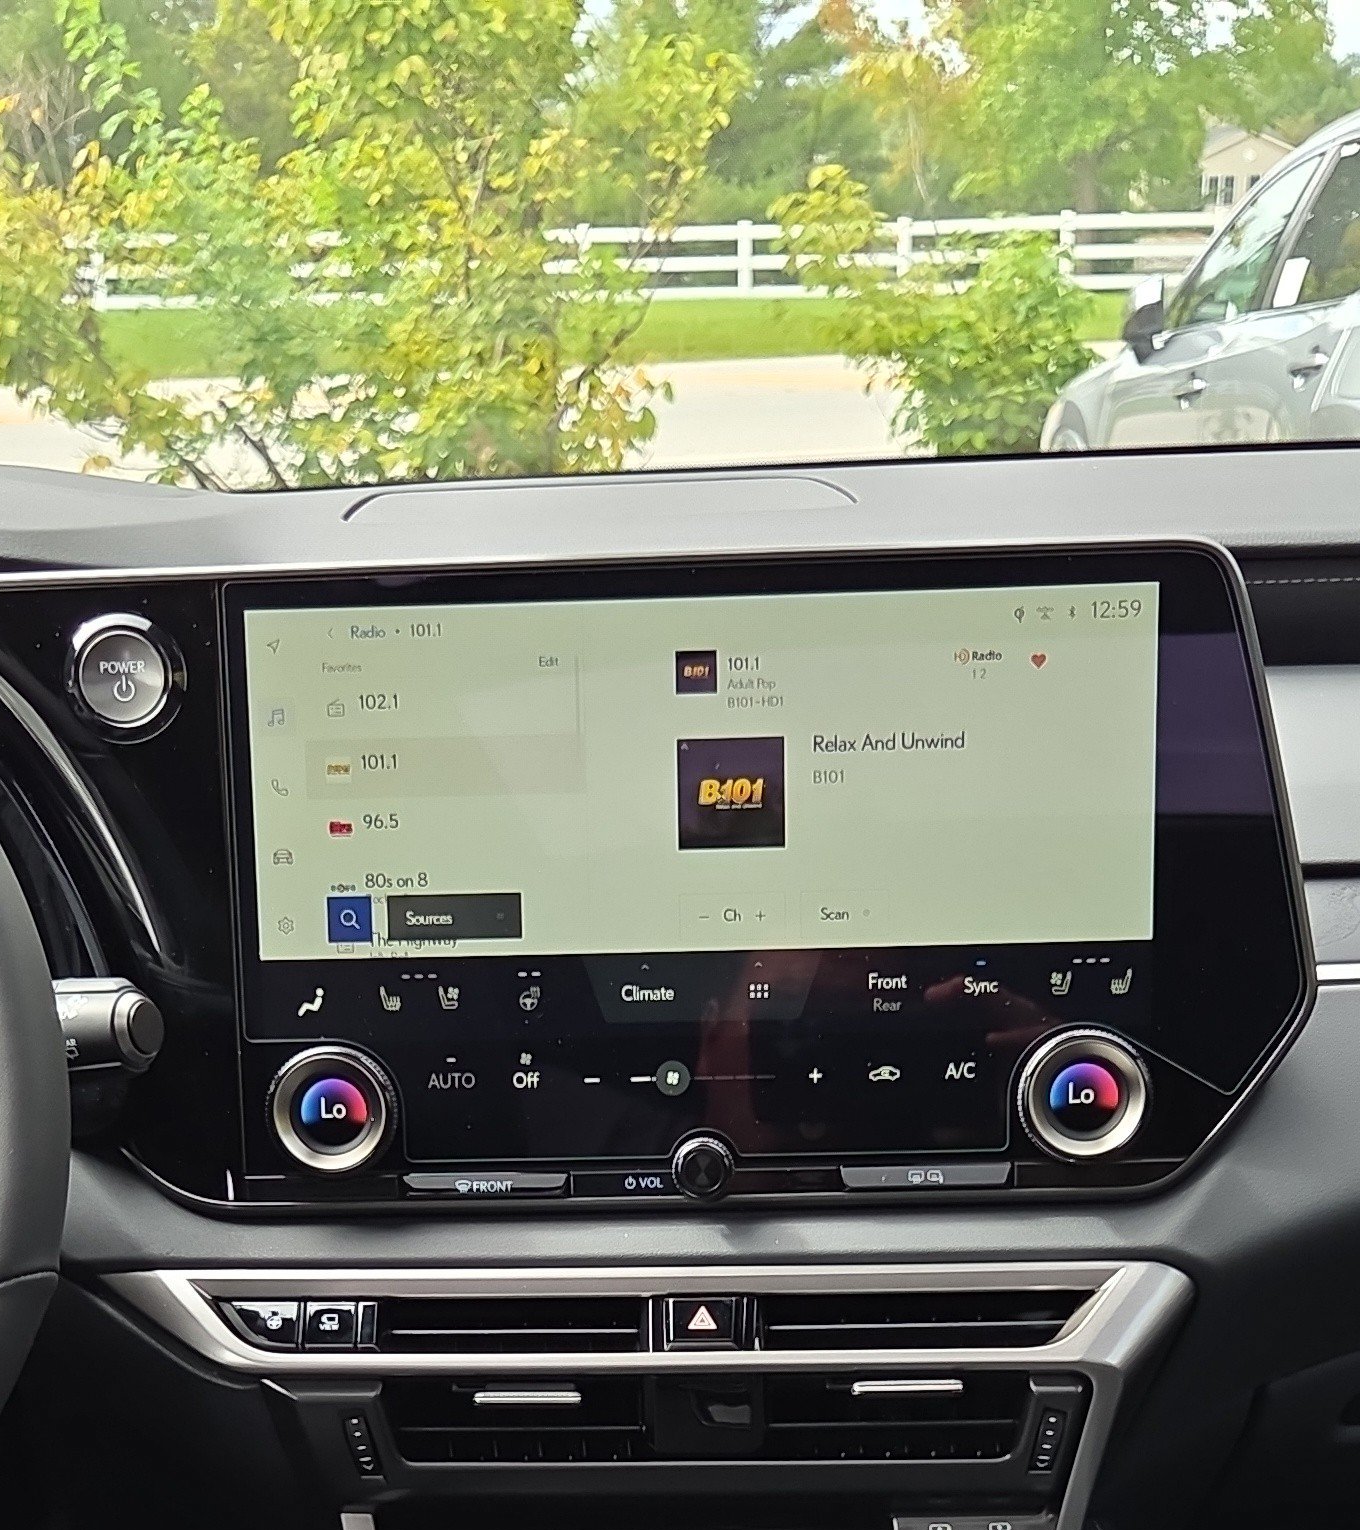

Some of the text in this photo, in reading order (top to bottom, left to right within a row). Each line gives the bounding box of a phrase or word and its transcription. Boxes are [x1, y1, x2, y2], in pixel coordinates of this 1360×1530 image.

[1091, 600, 1142, 619] 12:59
[350, 622, 443, 640] Radio 101.1
[728, 657, 760, 671] 101.1
[972, 651, 1002, 661] Radio
[99, 661, 145, 674] POWER
[321, 656, 559, 674] Favorites Edit
[727, 678, 777, 691] Adult Pop
[358, 693, 399, 711] 102.1
[727, 696, 784, 708] B101-HD1
[813, 731, 966, 753] Relax And Unwind
[361, 753, 398, 770] 101.1
[813, 770, 845, 784] B101
[698, 778, 764, 806] B101
[363, 813, 399, 829] 96.5
[365, 873, 393, 888] 80s
[397, 876, 414, 888] on
[417, 871, 429, 888] 8
[405, 910, 453, 926] Sources
[723, 907, 742, 923] Ch
[820, 907, 849, 922] Scan
[621, 984, 675, 1002] Climate
[868, 973, 998, 997] Front Sync
[873, 997, 902, 1012] Rear
[428, 1061, 976, 1090] AUTO Off A/C
[1068, 1083, 1095, 1106] Lo
[320, 1097, 347, 1121] Lo
[473, 1179, 513, 1194] FRONT
[640, 1176, 664, 1190] VOL
